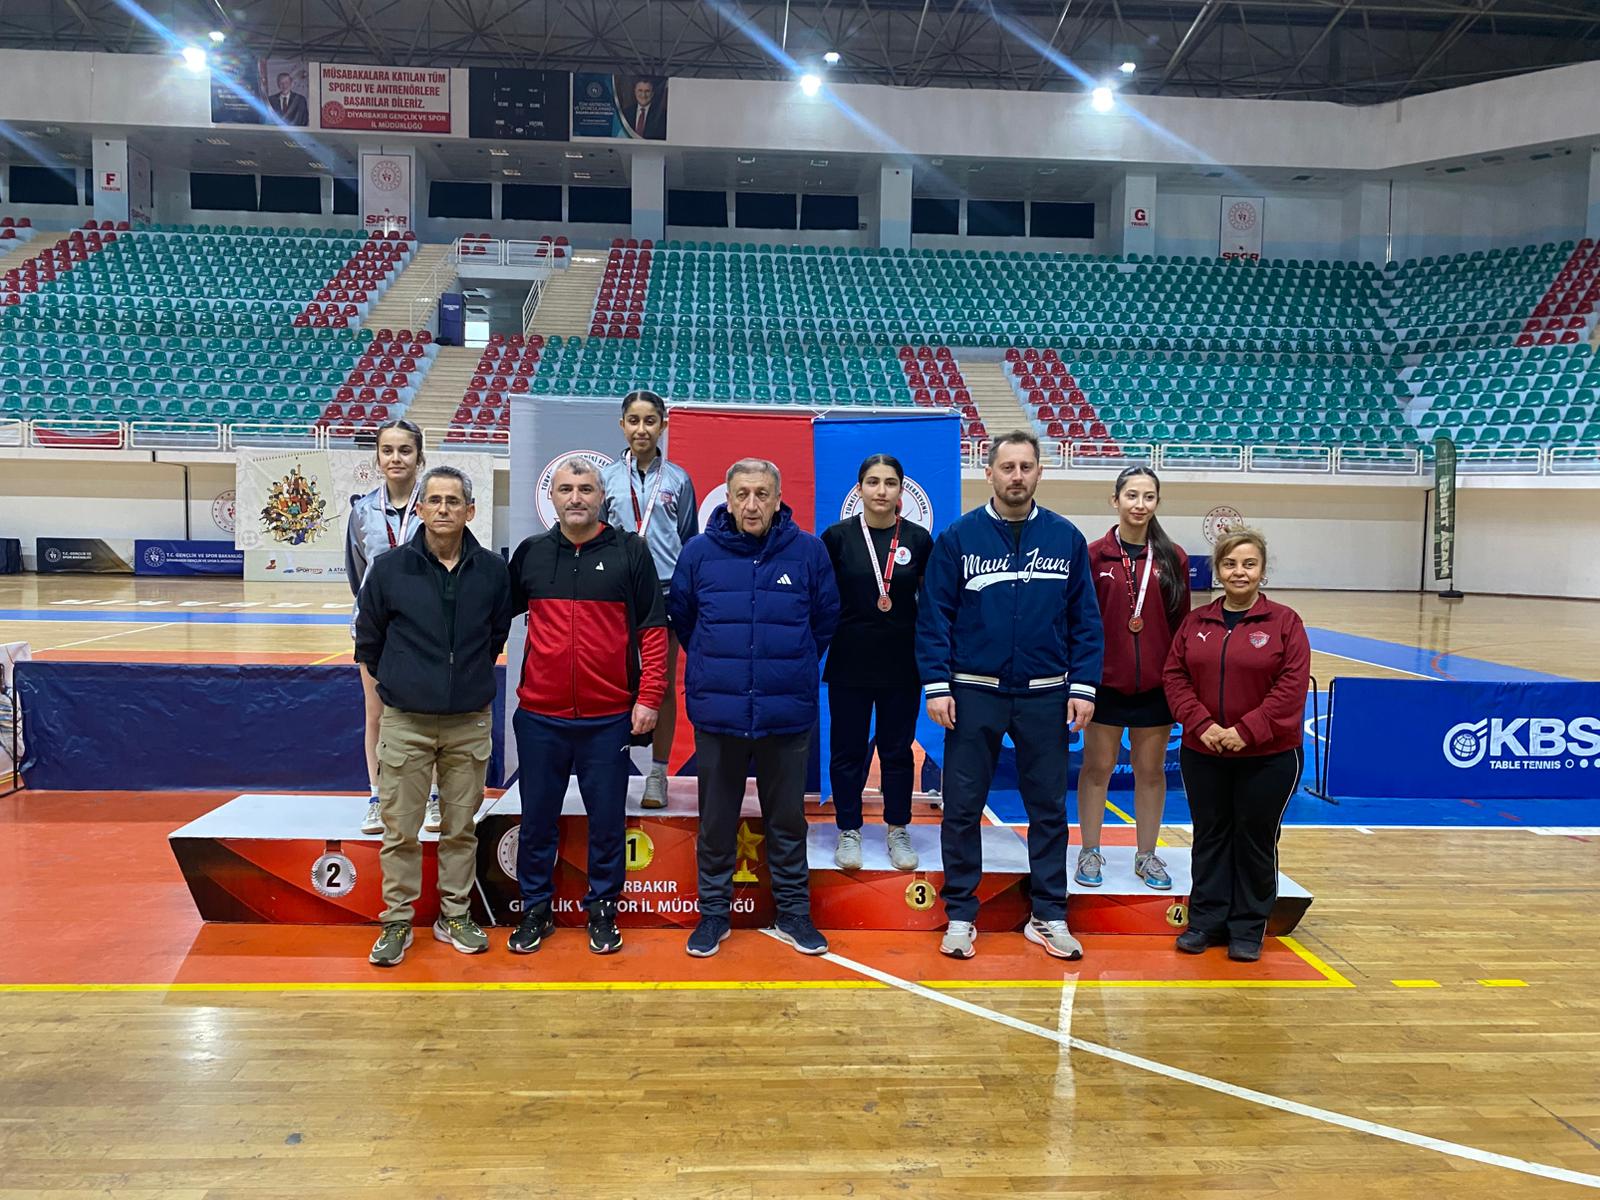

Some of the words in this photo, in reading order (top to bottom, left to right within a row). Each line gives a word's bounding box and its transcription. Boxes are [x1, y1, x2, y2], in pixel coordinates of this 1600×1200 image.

[323, 67, 390, 81] MÜSABAKALARA
[392, 71, 426, 82] KATILAN
[428, 72, 446, 83] TÜM
[328, 82, 362, 93] SPORCU
[365, 84, 374, 94] VE
[376, 84, 440, 97] ANTRENÖRLERE
[344, 96, 389, 108] BAŞARILAR
[391, 96, 425, 109] DİLERİZ.
[106, 173, 116, 186] F
[1134, 209, 1146, 221] G
[961, 553, 1010, 580] Mavi
[1022, 548, 1070, 583] Jeans
[1489, 716, 1600, 757] KBS
[1489, 760, 1521, 770] TABLE
[1522, 760, 1561, 770] TENNIS
[627, 838, 637, 862] 1
[326, 862, 342, 888] 2
[915, 886, 926, 905] 3
[641, 898, 654, 913] İL
[1173, 908, 1183, 923] 4
